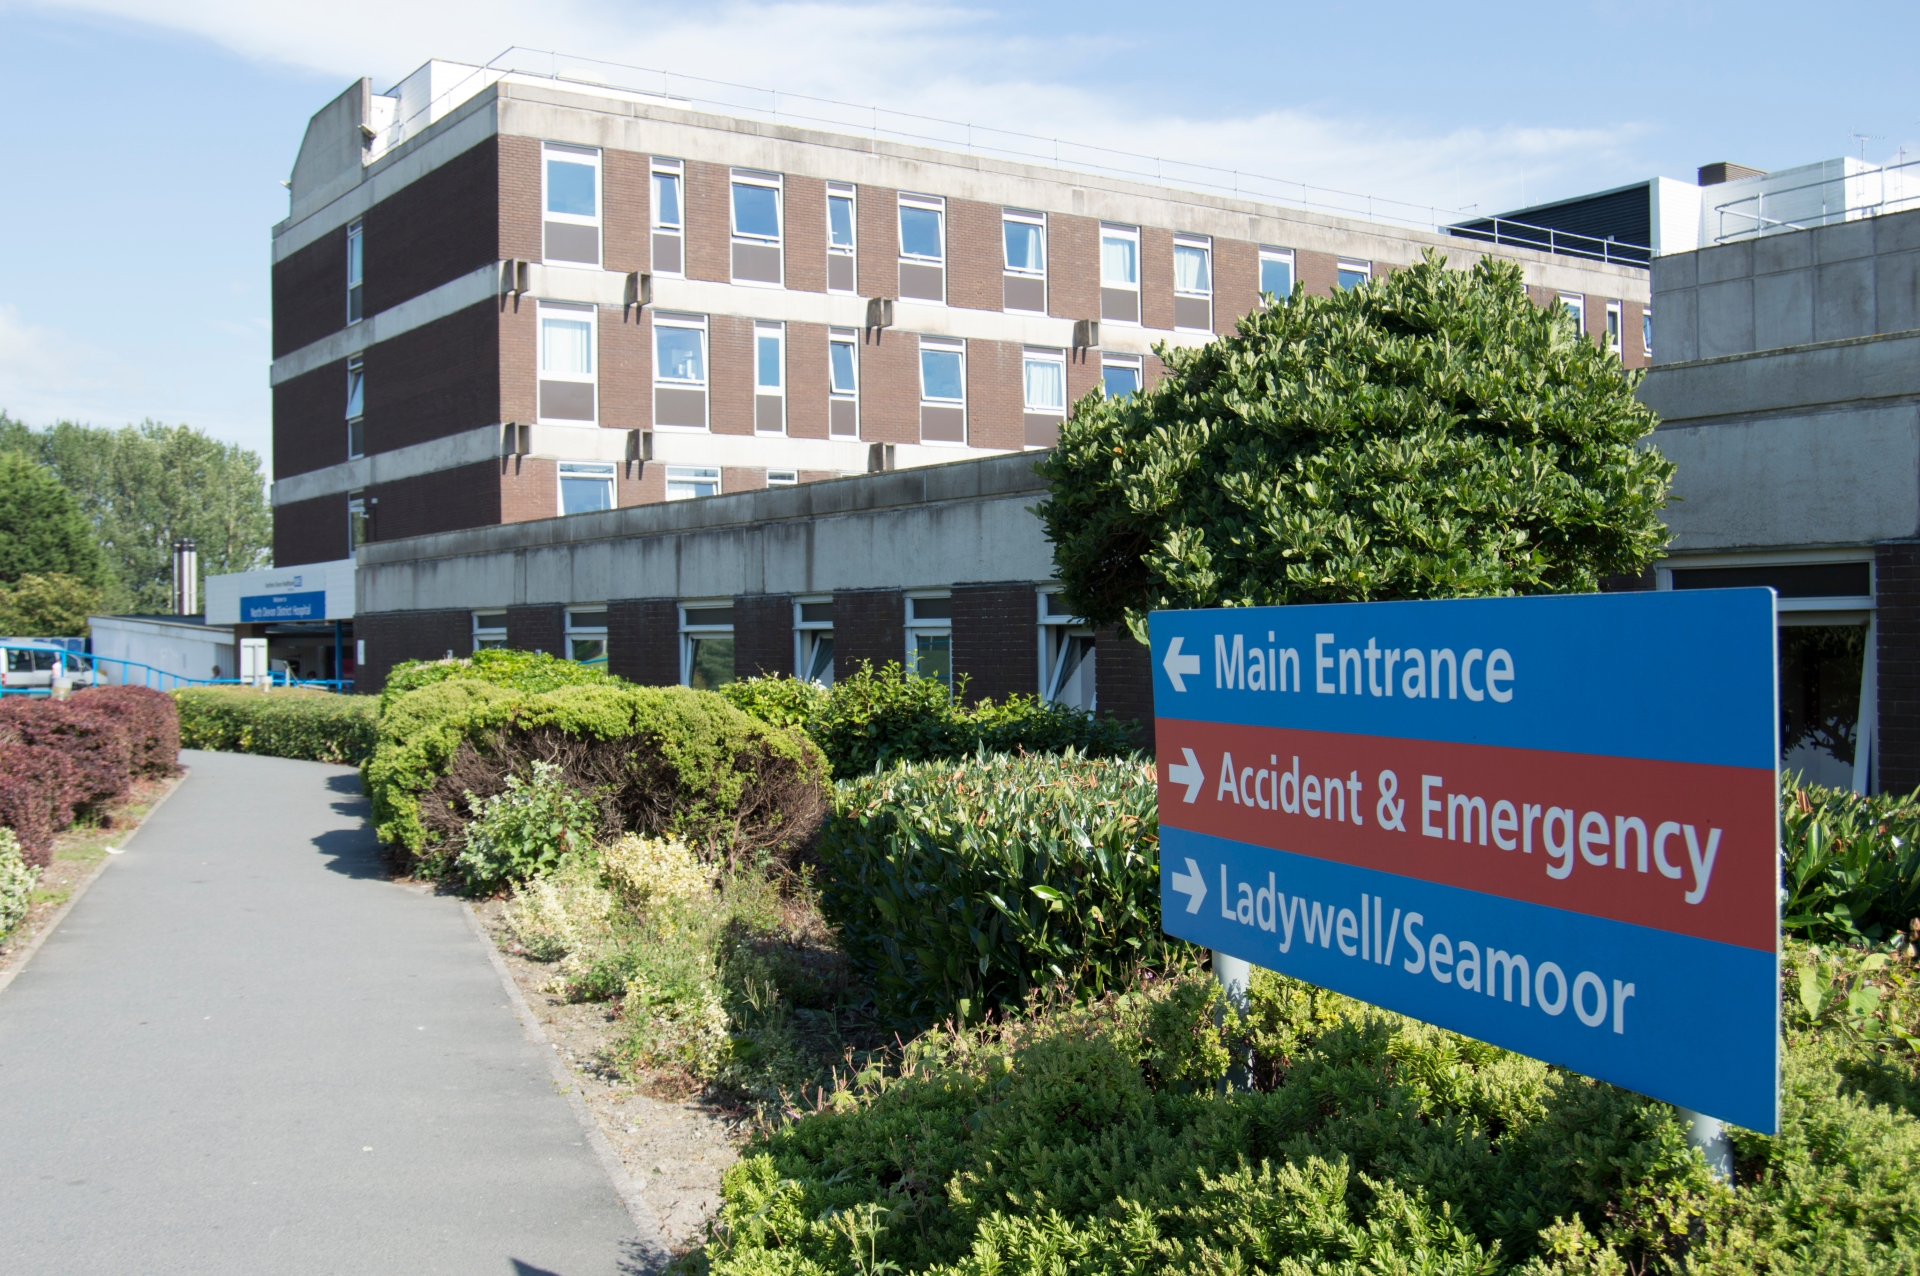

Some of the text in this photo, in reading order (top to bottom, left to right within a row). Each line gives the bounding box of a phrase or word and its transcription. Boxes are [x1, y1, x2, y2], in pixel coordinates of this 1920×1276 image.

[292, 604, 311, 618] Hospital
[1214, 631, 1516, 703] Main Entrance
[1217, 751, 1723, 905] Accident & Emergency
[1221, 863, 1636, 1035] Ladywell/Seamoor
